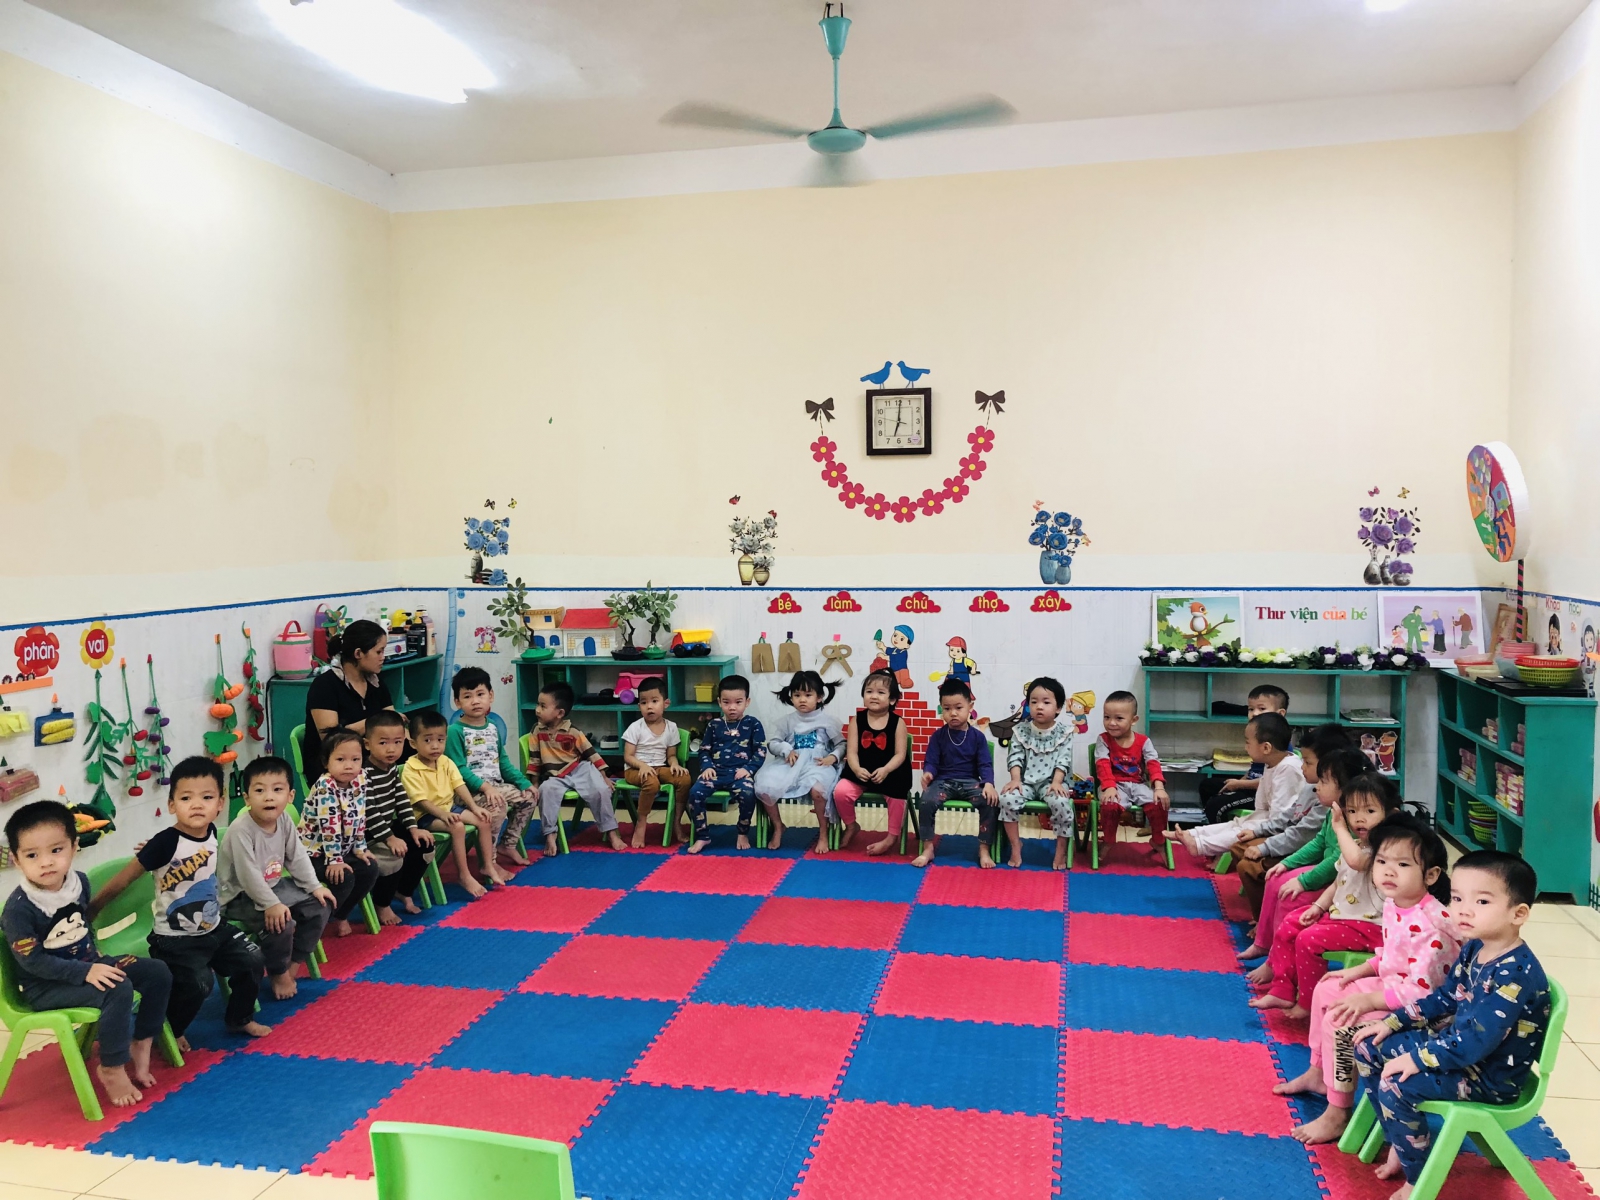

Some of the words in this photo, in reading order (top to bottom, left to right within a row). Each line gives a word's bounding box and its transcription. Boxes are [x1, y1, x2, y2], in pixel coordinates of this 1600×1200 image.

[777, 598, 792, 611] Bé
[831, 598, 853, 610] làm
[905, 597, 928, 610] chú
[978, 597, 998, 611] thợ
[1038, 595, 1060, 610] xây
[1255, 606, 1286, 620] Thư
[1290, 607, 1318, 623] viện
[1322, 606, 1347, 620] của
[1351, 607, 1367, 620] bé
[24, 641, 55, 665] phân
[88, 635, 105, 654] vai
[159, 845, 210, 891] BATMAN
